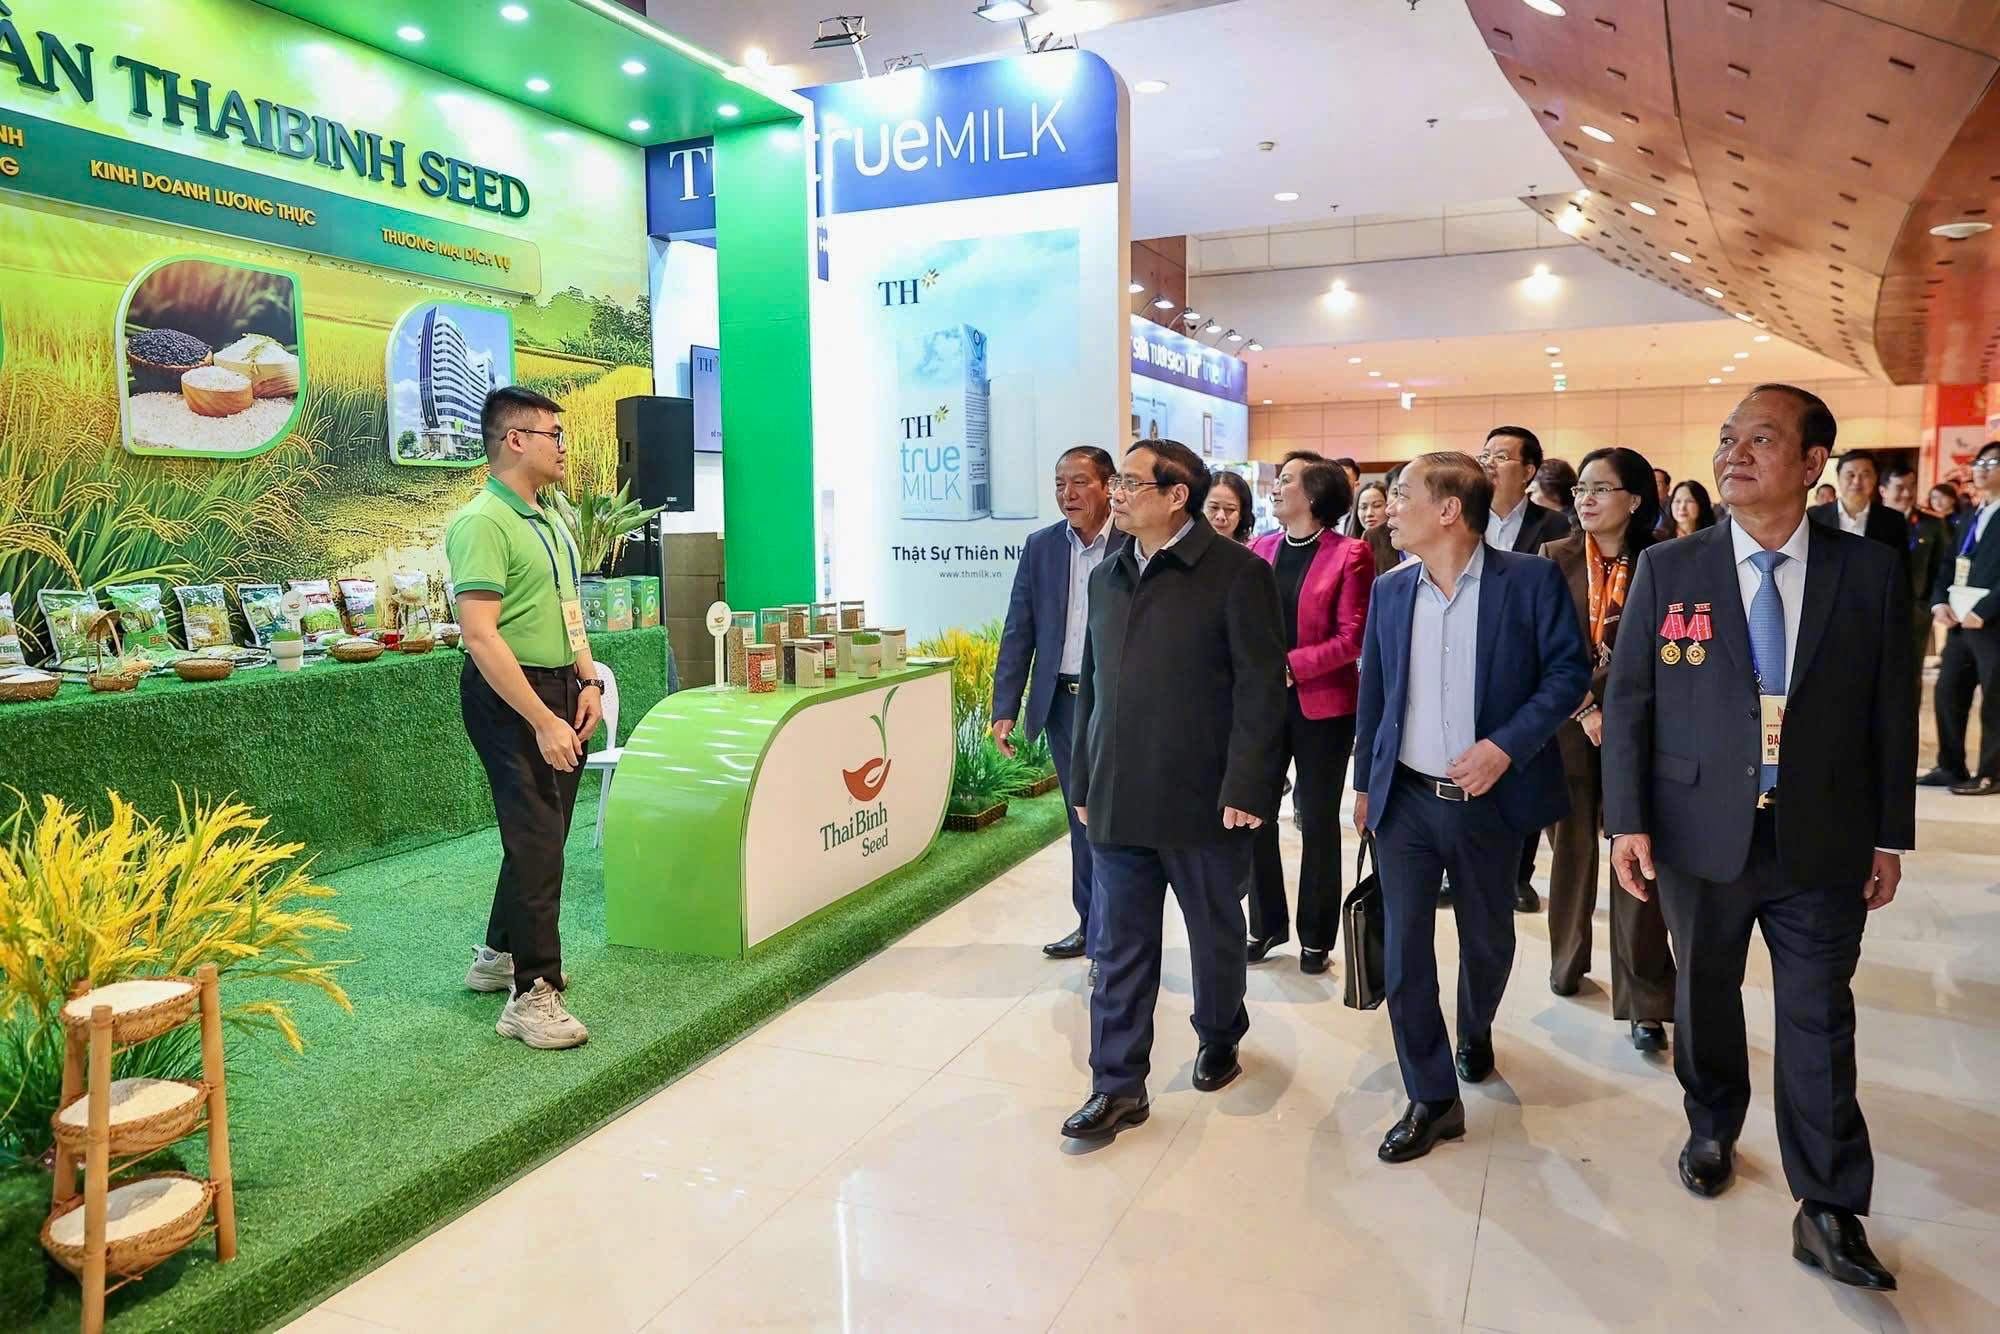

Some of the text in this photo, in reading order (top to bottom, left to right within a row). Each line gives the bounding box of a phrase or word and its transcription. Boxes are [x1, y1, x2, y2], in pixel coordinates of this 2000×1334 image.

[112, 55, 406, 187] THAIBINH
[418, 150, 531, 219] SEED
[90, 159, 138, 186] KINH
[142, 171, 211, 203] DOANH
[878, 279, 920, 306] TH
[900, 415, 933, 439] TH
[900, 442, 960, 472] true
[902, 473, 962, 500] MILK
[892, 546, 926, 563] Thật
[931, 546, 951, 563] Sự
[955, 544, 999, 561] Thiên
[939, 569, 1002, 579] www.thmilk.vn
[862, 828, 889, 857] Seed
